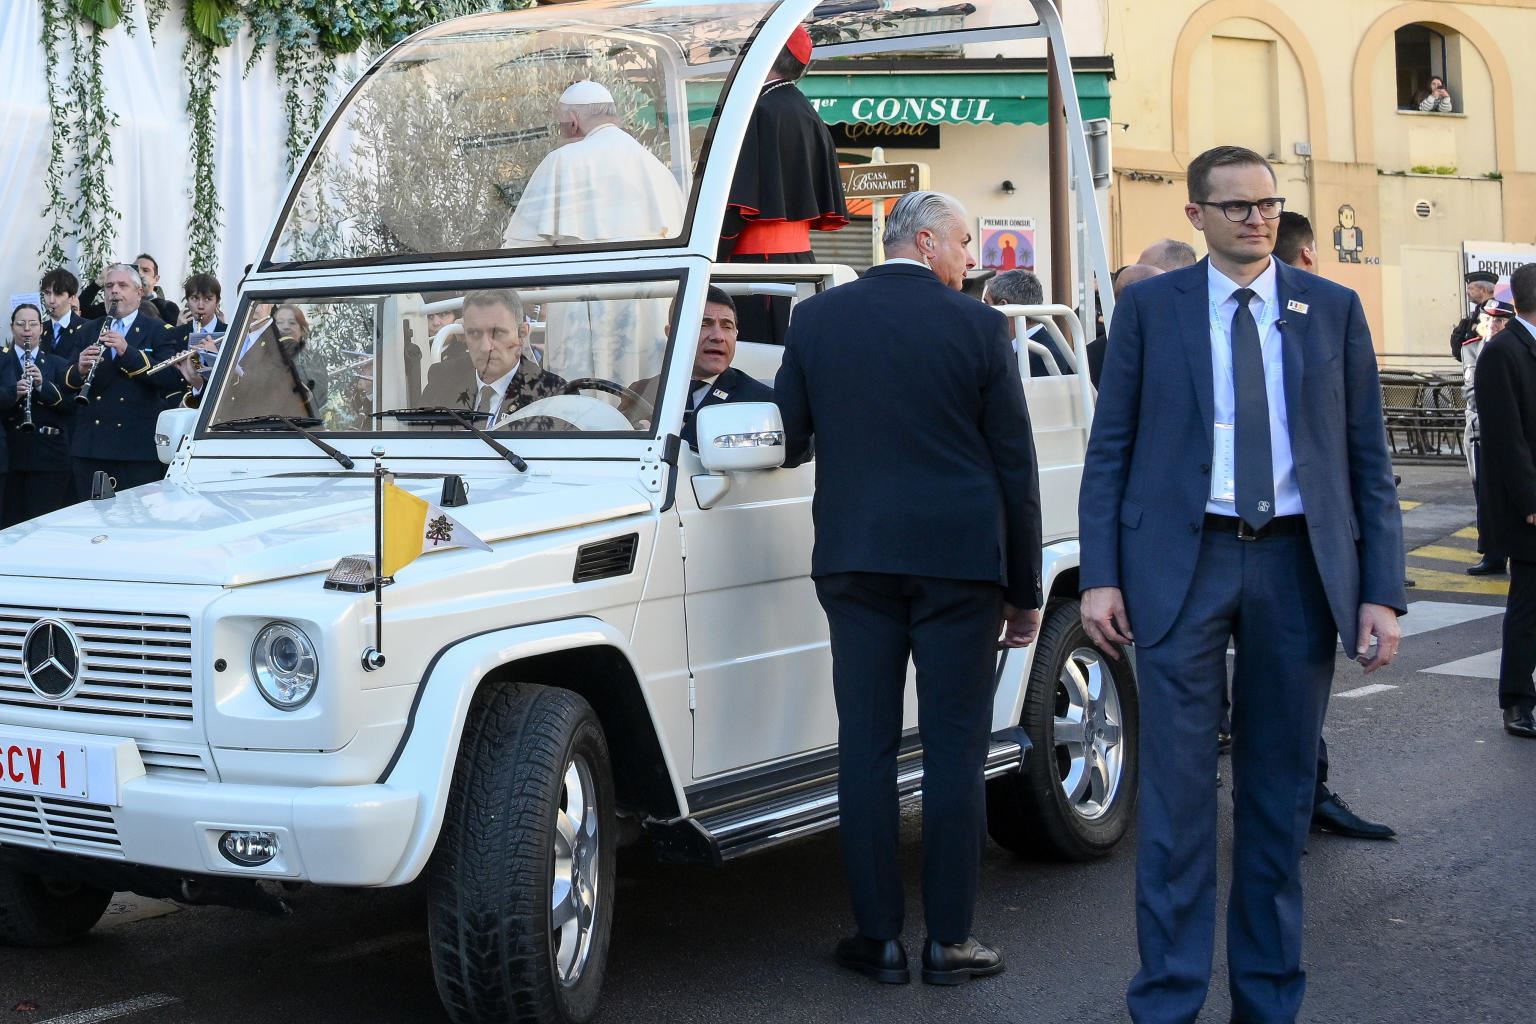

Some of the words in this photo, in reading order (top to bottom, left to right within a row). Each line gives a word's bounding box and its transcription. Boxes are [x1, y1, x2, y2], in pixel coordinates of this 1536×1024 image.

[852, 97, 995, 121] CONSUL
[853, 173, 907, 192] BONAPARTE
[868, 171, 887, 180] CASA
[56, 750, 67, 789] 1
